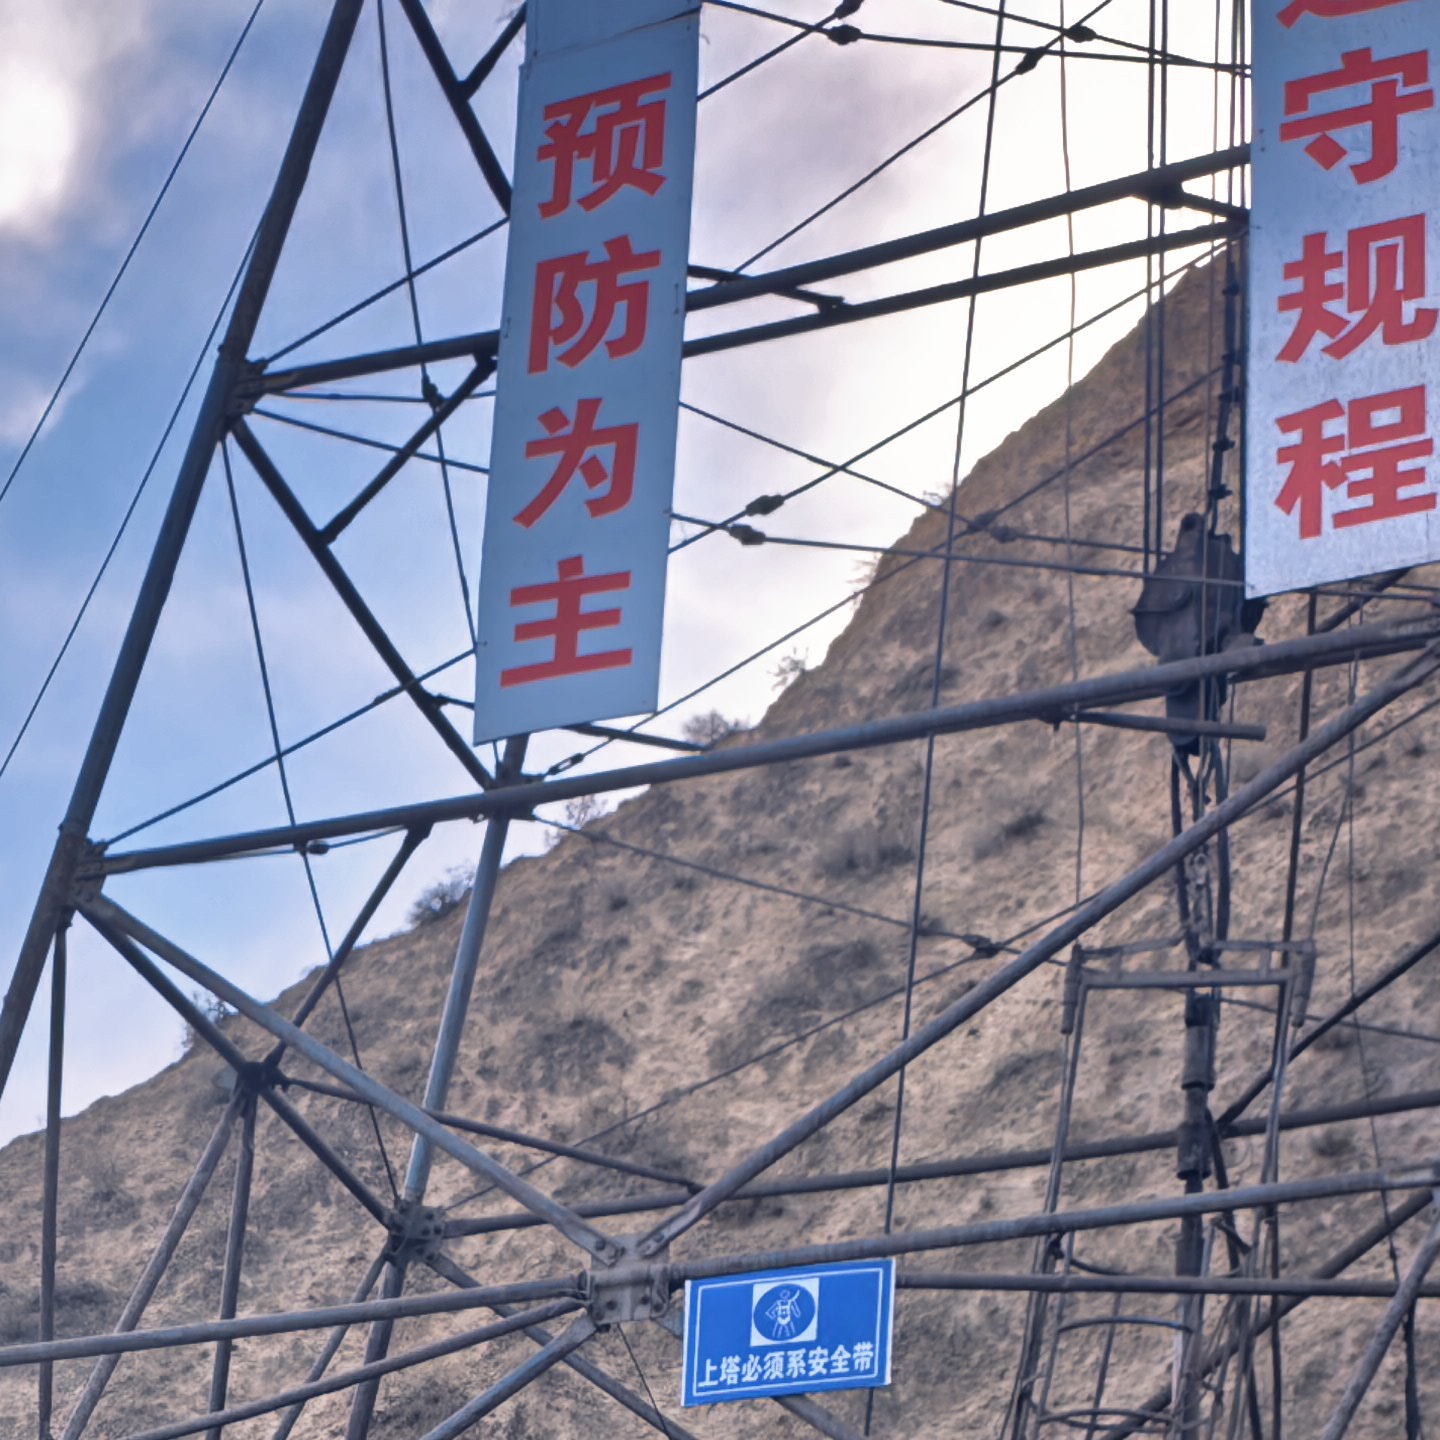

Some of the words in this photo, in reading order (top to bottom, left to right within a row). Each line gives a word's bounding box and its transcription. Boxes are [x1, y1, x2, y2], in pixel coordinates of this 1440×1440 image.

[498, 70, 674, 688] 预防为主
[1274, 0, 1440, 540] 守规程
[697, 1340, 875, 1388] 上塔必须系安全带
